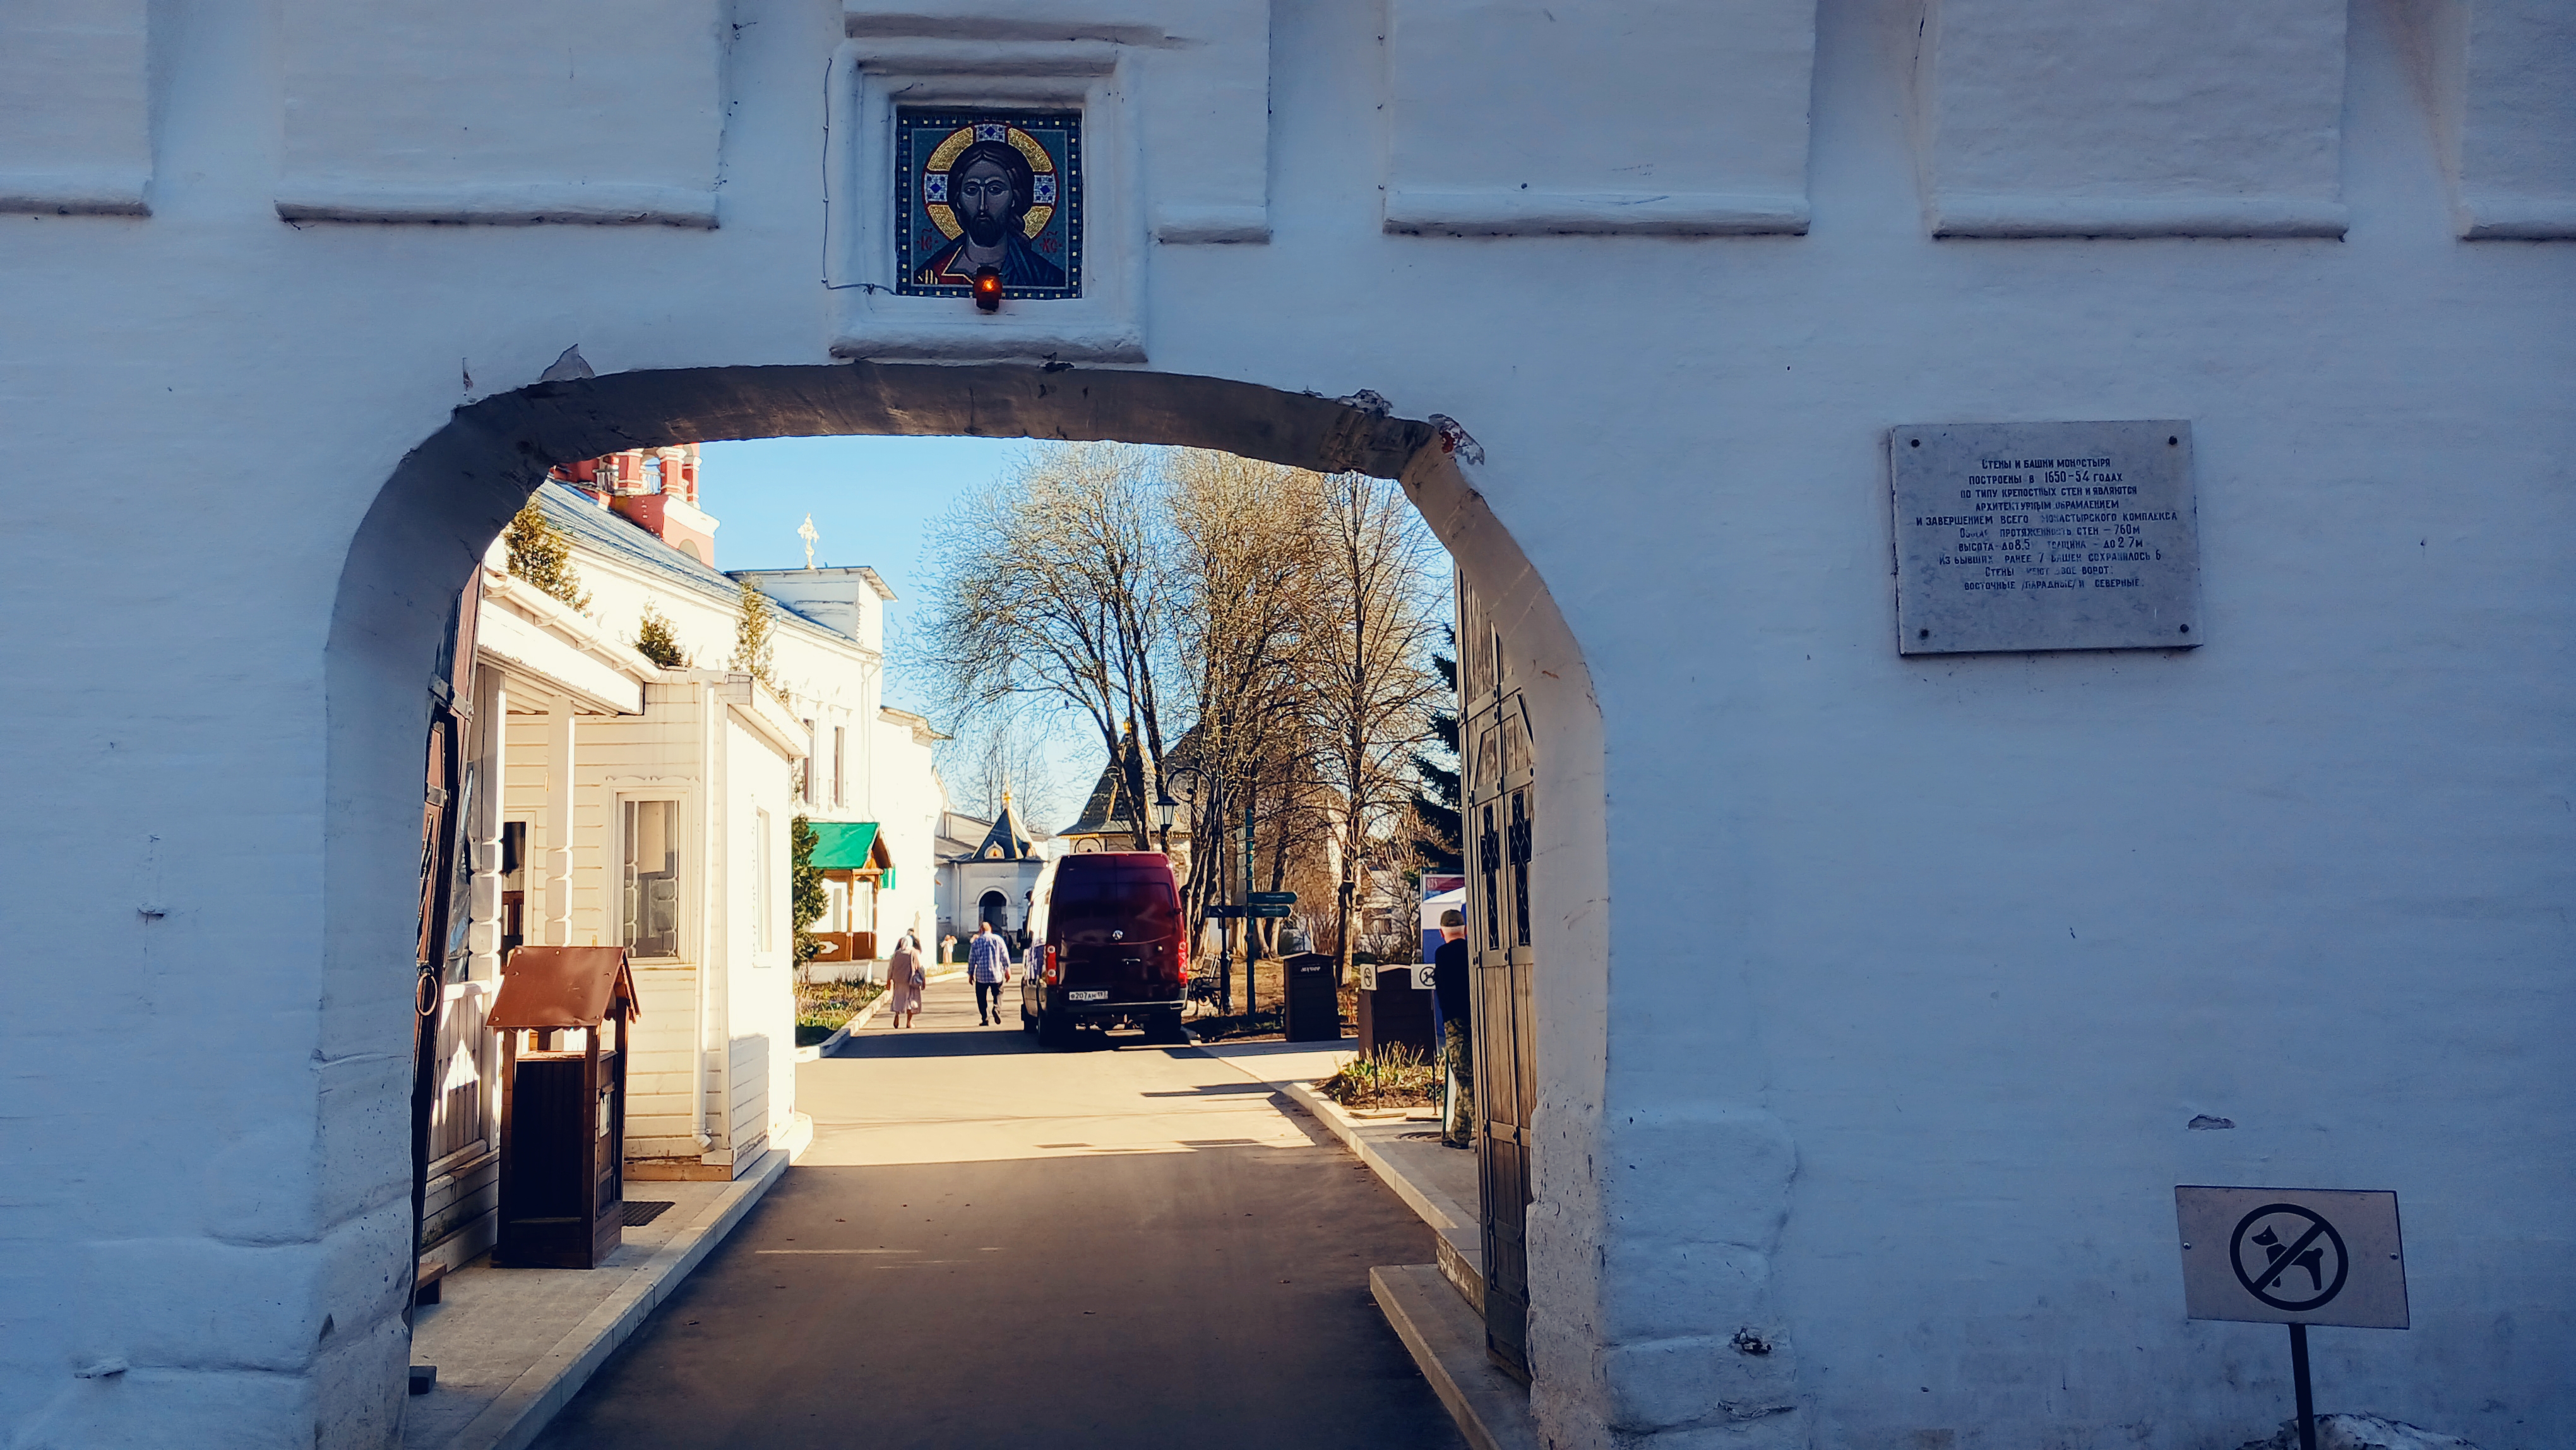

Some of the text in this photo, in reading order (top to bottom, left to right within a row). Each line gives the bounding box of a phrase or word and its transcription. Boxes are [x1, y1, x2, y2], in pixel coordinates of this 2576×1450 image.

[2015, 460, 2021, 469] И
[2024, 459, 2054, 469] БАШНИ
[1969, 475, 2022, 485] ПОСТРОЕНЫ
[2029, 474, 2035, 484] В
[2094, 472, 2123, 482] ГОДАХ
[1960, 489, 1971, 498] ПО
[1976, 489, 1998, 498] ТИПУ
[2061, 487, 2082, 496] СТЕН
[2085, 486, 2090, 496] И
[2092, 486, 2137, 496] ЯВЛЯЮТСЯ
[1916, 517, 1923, 526] И
[1926, 515, 1993, 526] ЗАВЕРШЕНИЕМ
[2000, 515, 2029, 524] ВСЕГО
[2123, 511, 2178, 522] КОМПЛЕКСА
[2077, 526, 2099, 536] СТЕН
[1959, 542, 1995, 552] ВЫСОТА
[2005, 554, 2032, 563] РАНЕЕ
[1964, 580, 2016, 590] ВОСТОЧНЫЕ
